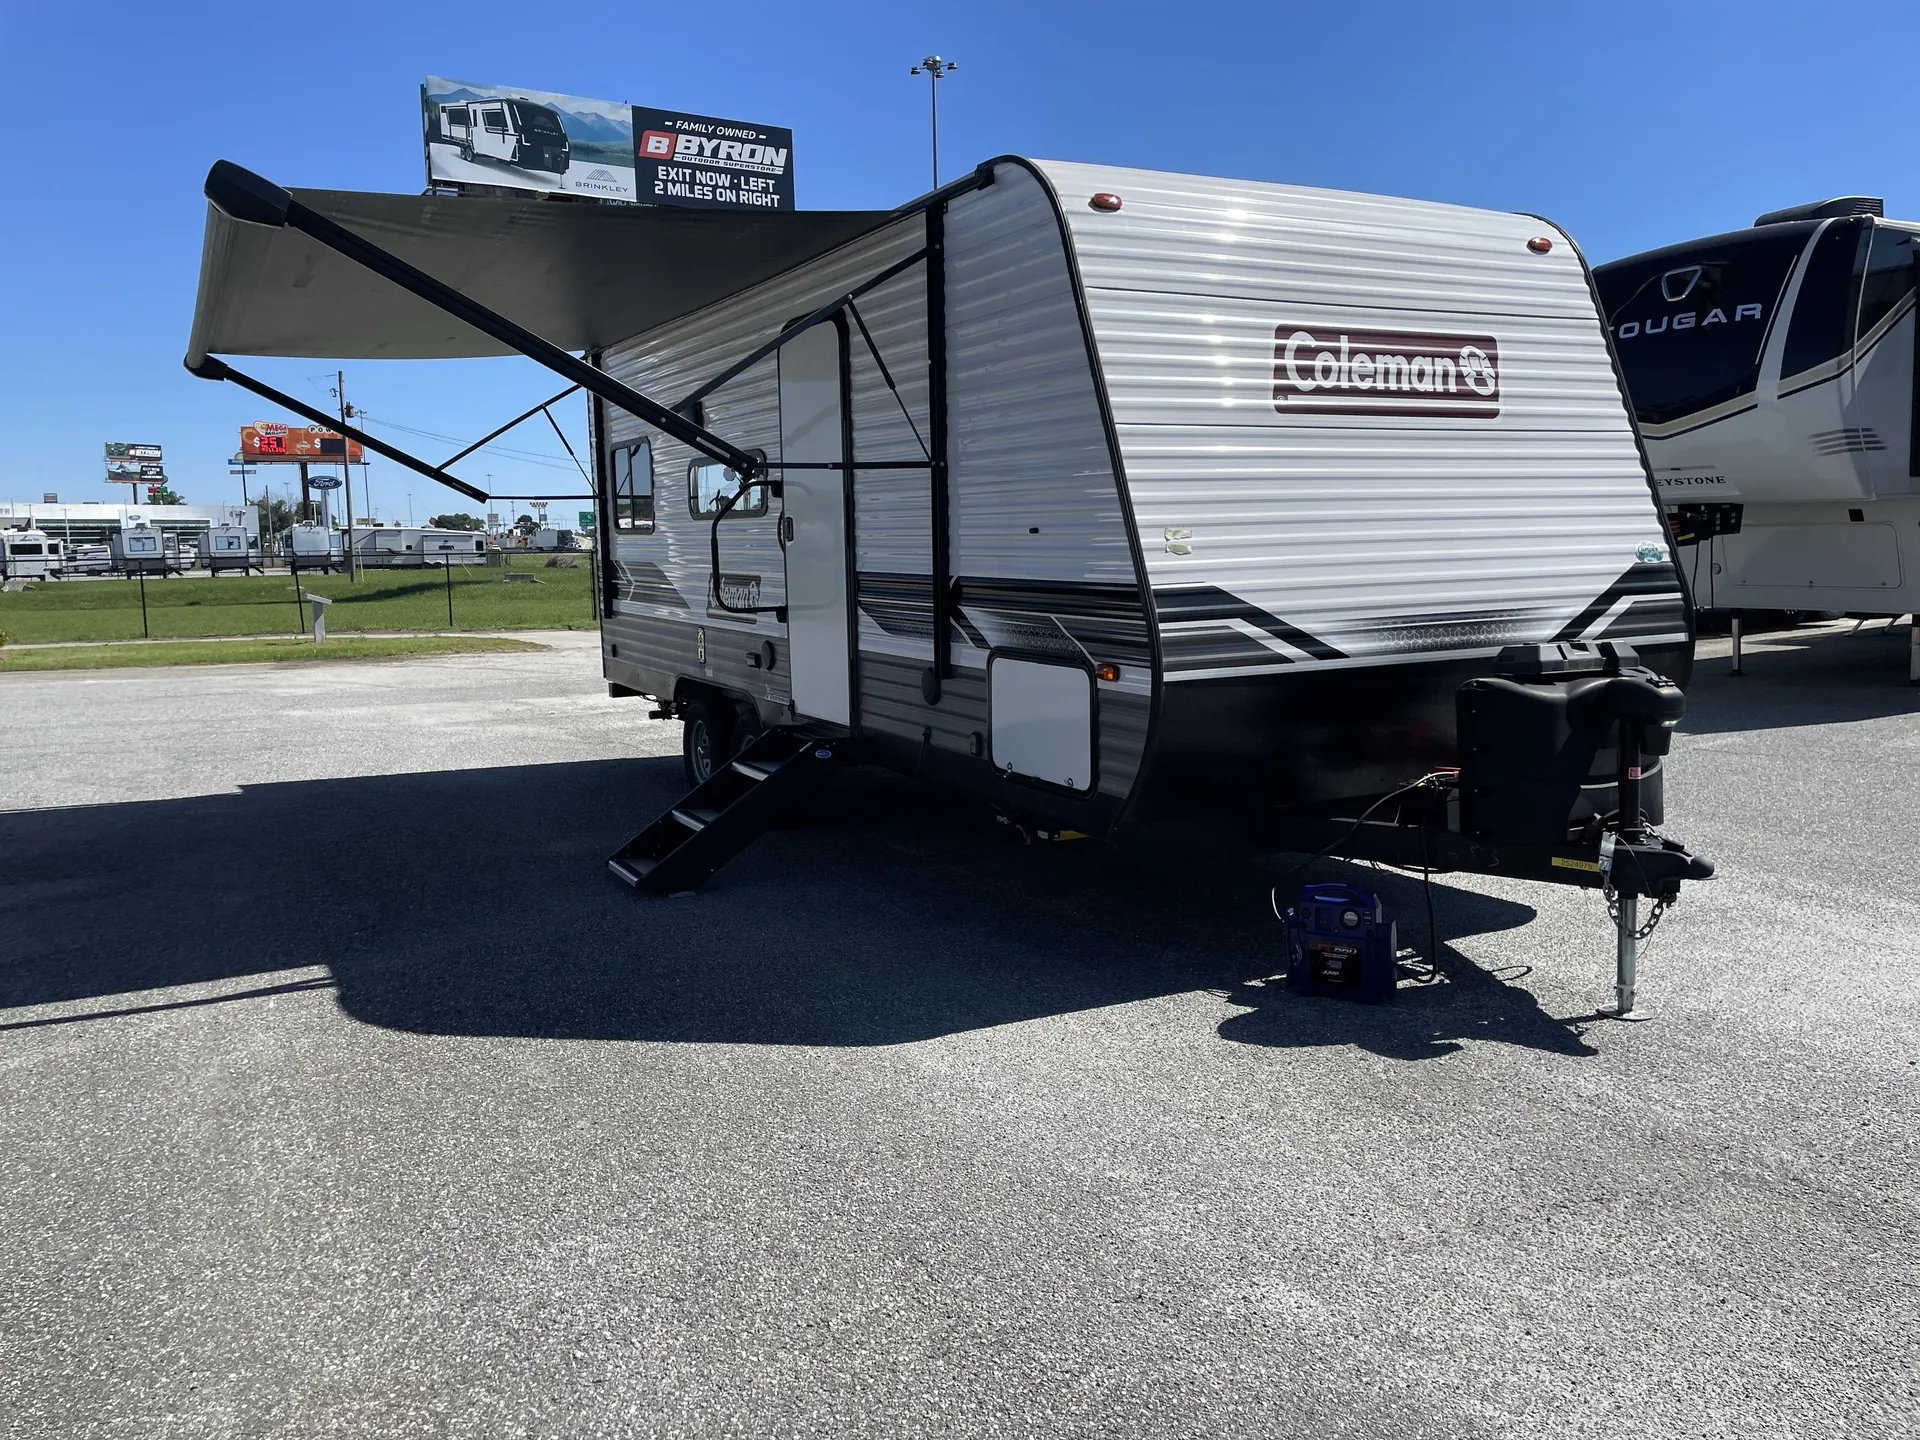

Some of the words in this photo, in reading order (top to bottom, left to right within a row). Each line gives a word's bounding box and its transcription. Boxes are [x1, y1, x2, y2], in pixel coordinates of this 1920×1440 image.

[676, 120, 714, 134] FAMILY
[716, 126, 756, 139] OWNED
[677, 134, 787, 167] BYRON
[681, 155, 720, 165] OUTDOOR
[723, 161, 776, 173] SUPERSTORE
[575, 181, 629, 193] BRINKLEY
[657, 165, 692, 182] EXIT
[695, 171, 731, 187] NOW
[740, 176, 776, 193] LEFT
[654, 181, 664, 195] 2
[667, 182, 713, 200] MILES
[716, 188, 737, 202] ON
[740, 190, 780, 208] RIGHT
[1611, 302, 1763, 339] OUGAR
[1284, 330, 1457, 393] Coleman
[265, 423, 287, 432] MEGA
[313, 478, 336, 488] Ford
[1655, 475, 1727, 487] EYSTONE
[710, 576, 749, 609] Cleman
